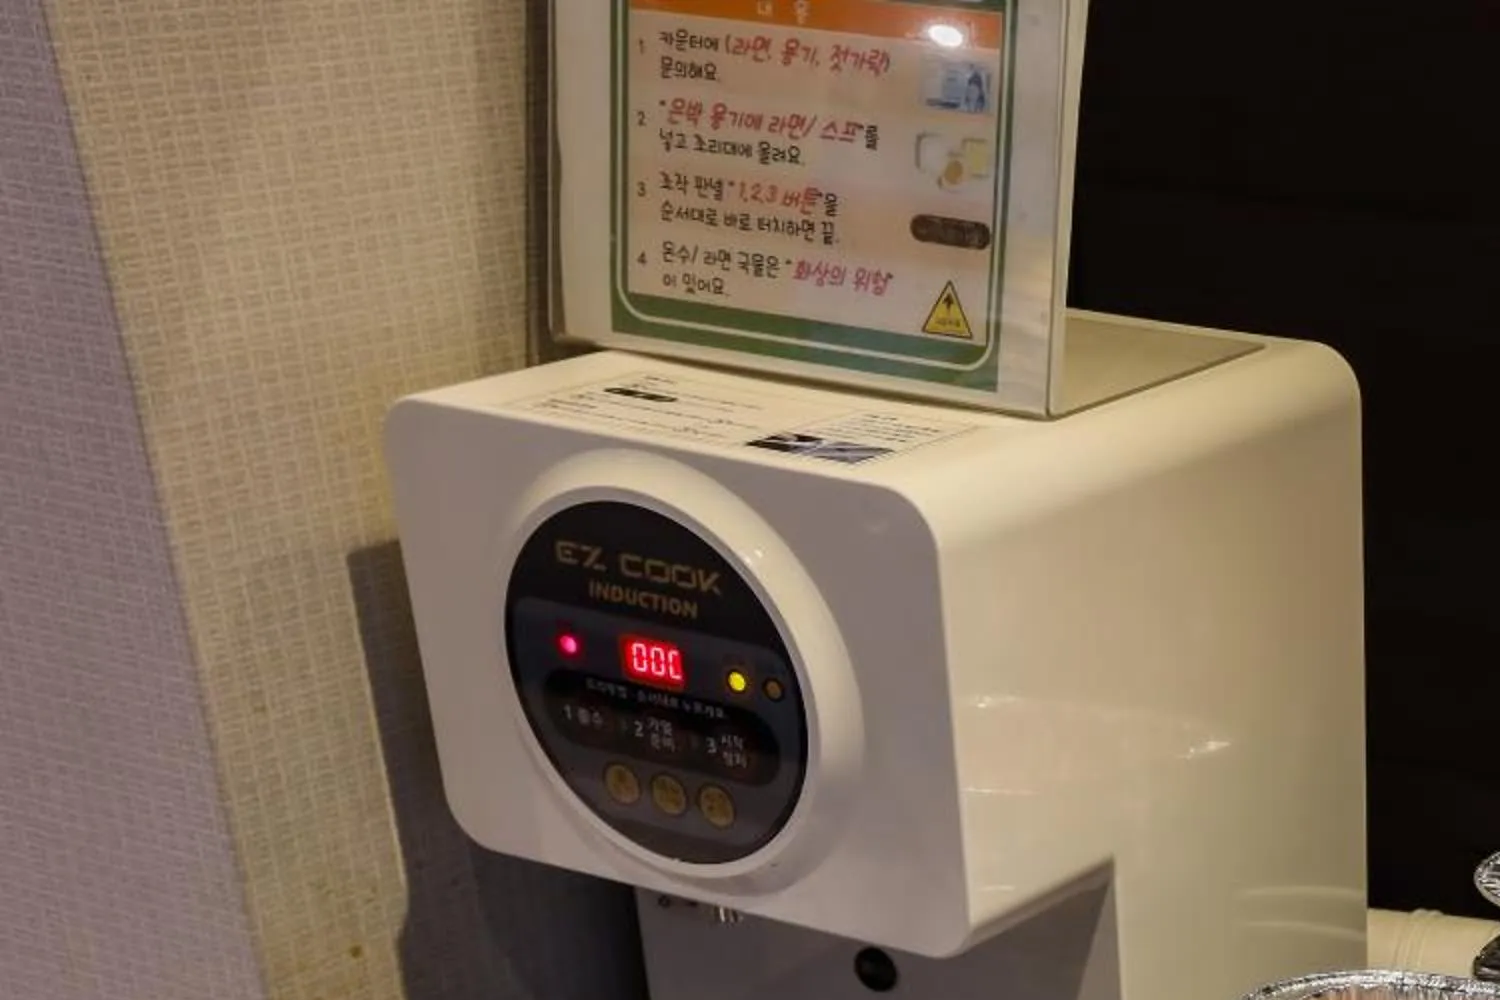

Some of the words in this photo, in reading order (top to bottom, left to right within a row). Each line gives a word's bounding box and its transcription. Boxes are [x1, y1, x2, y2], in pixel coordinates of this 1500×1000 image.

[659, 28, 720, 51] 카운터에
[636, 111, 646, 126] 2
[709, 102, 764, 131] 용기에
[659, 126, 688, 152] 넣고
[693, 132, 753, 158] 조리대에
[636, 181, 646, 198] 3
[659, 170, 688, 196] 조작
[693, 174, 724, 202] 판넬
[660, 199, 719, 228] 순서대로
[723, 212, 752, 232] 바로
[756, 216, 816, 243] 터치하면
[636, 250, 647, 266] 4
[702, 249, 731, 271] 라면
[737, 250, 780, 279] 국물은
[661, 273, 677, 287] 이
[554, 539, 607, 573] EZ
[618, 553, 722, 597] COOK
[588, 579, 699, 620] INDUCTION
[633, 720, 645, 738] 2
[705, 737, 718, 754] 3
